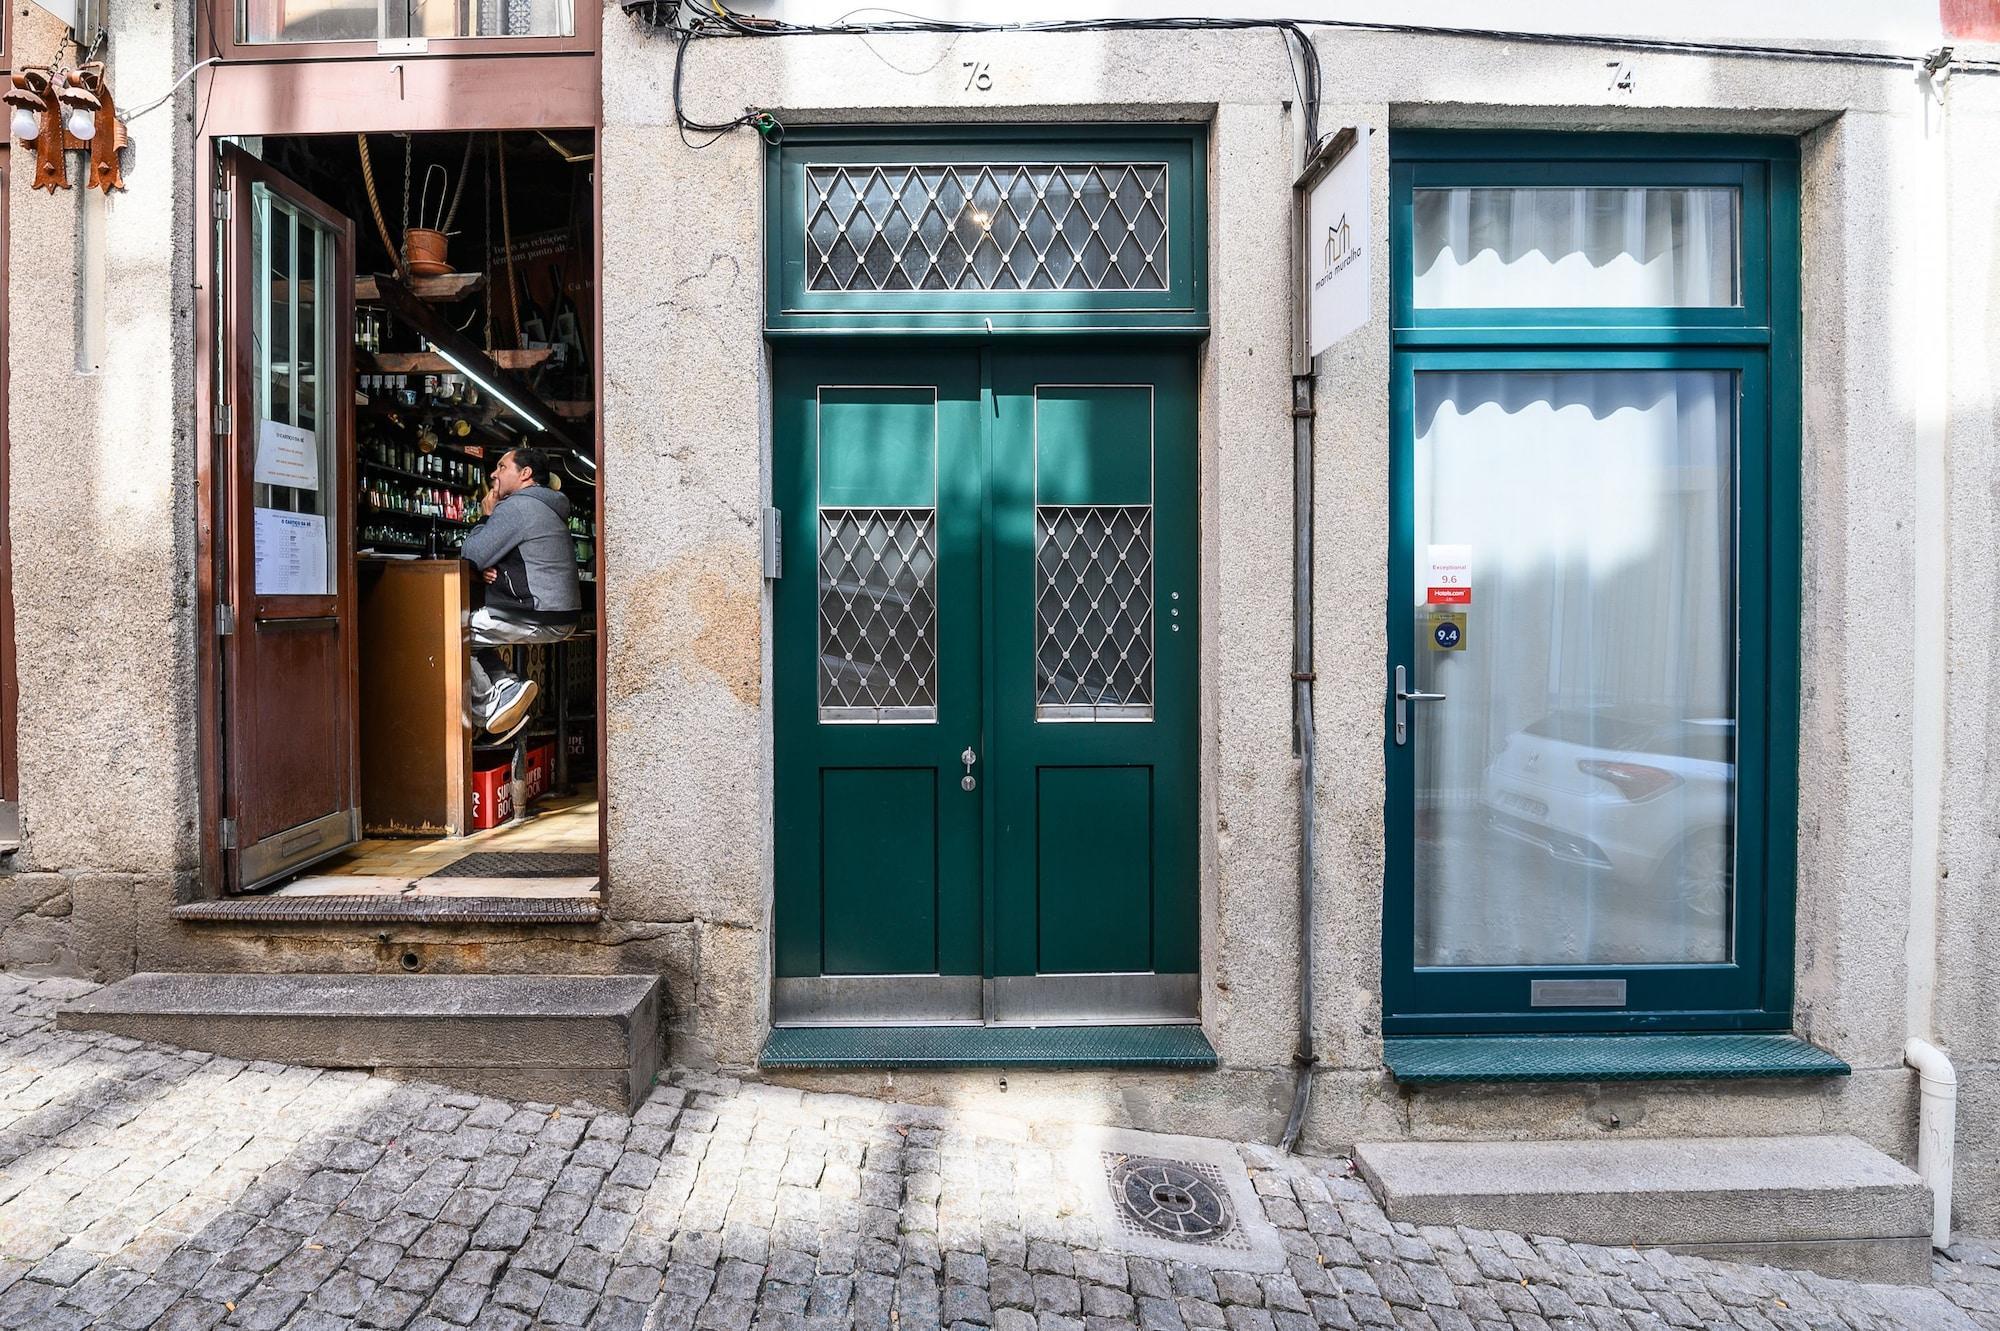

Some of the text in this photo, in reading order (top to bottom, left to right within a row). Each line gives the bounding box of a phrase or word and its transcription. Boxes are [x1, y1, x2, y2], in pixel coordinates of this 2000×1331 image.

[963, 62, 992, 91] 76
[1606, 62, 1635, 94] 74
[1315, 248, 1361, 291] maria muralha
[1442, 575, 1457, 584] 9.6
[1438, 630, 1457, 640] 9.4
[526, 767, 542, 785] UPER
[526, 781, 541, 799] OCK
[497, 797, 513, 819] BOC
